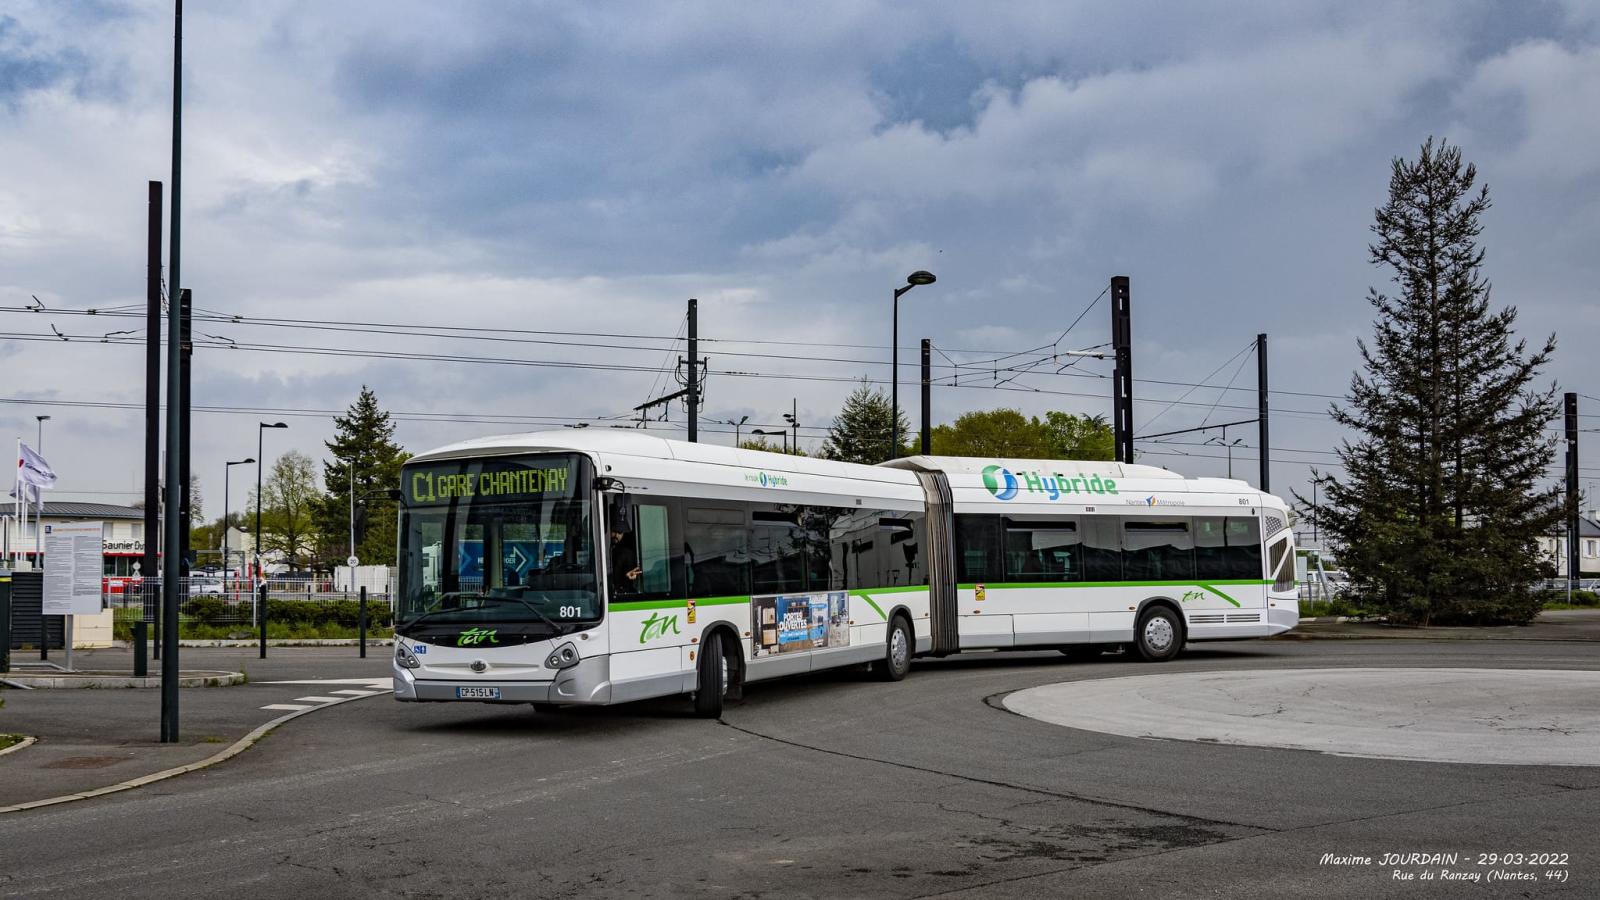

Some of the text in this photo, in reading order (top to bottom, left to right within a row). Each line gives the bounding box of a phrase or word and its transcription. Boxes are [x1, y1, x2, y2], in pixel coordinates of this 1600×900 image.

[412, 467, 568, 503] C1 GARE CHANTENAY
[1022, 471, 1119, 501] Hybride
[102, 540, 134, 550] Saunier
[560, 606, 581, 618] 801
[783, 613, 803, 622] PORTES
[779, 619, 807, 631] OUVERTES
